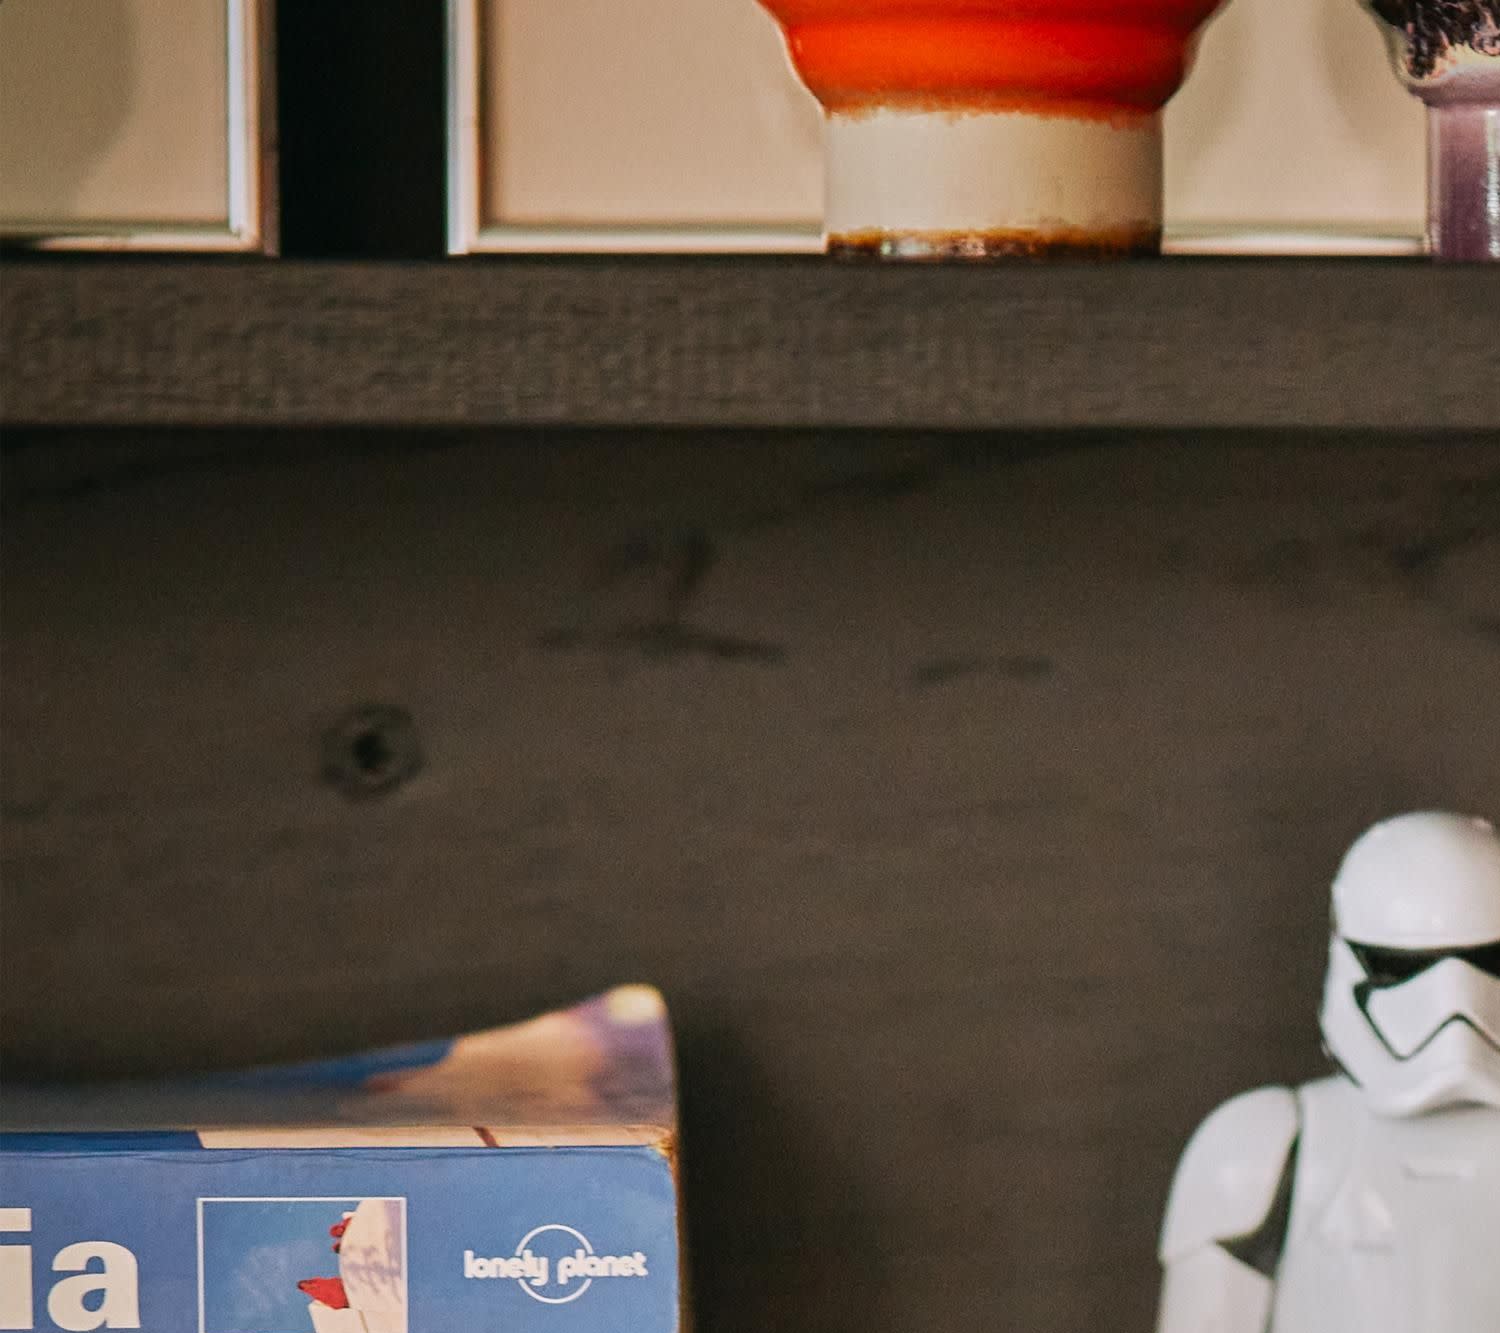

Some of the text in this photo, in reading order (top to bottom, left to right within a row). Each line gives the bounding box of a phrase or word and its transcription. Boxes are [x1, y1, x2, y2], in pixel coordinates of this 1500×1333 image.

[0, 1207, 141, 1332] ia
[464, 1249, 648, 1286] lonely planet
